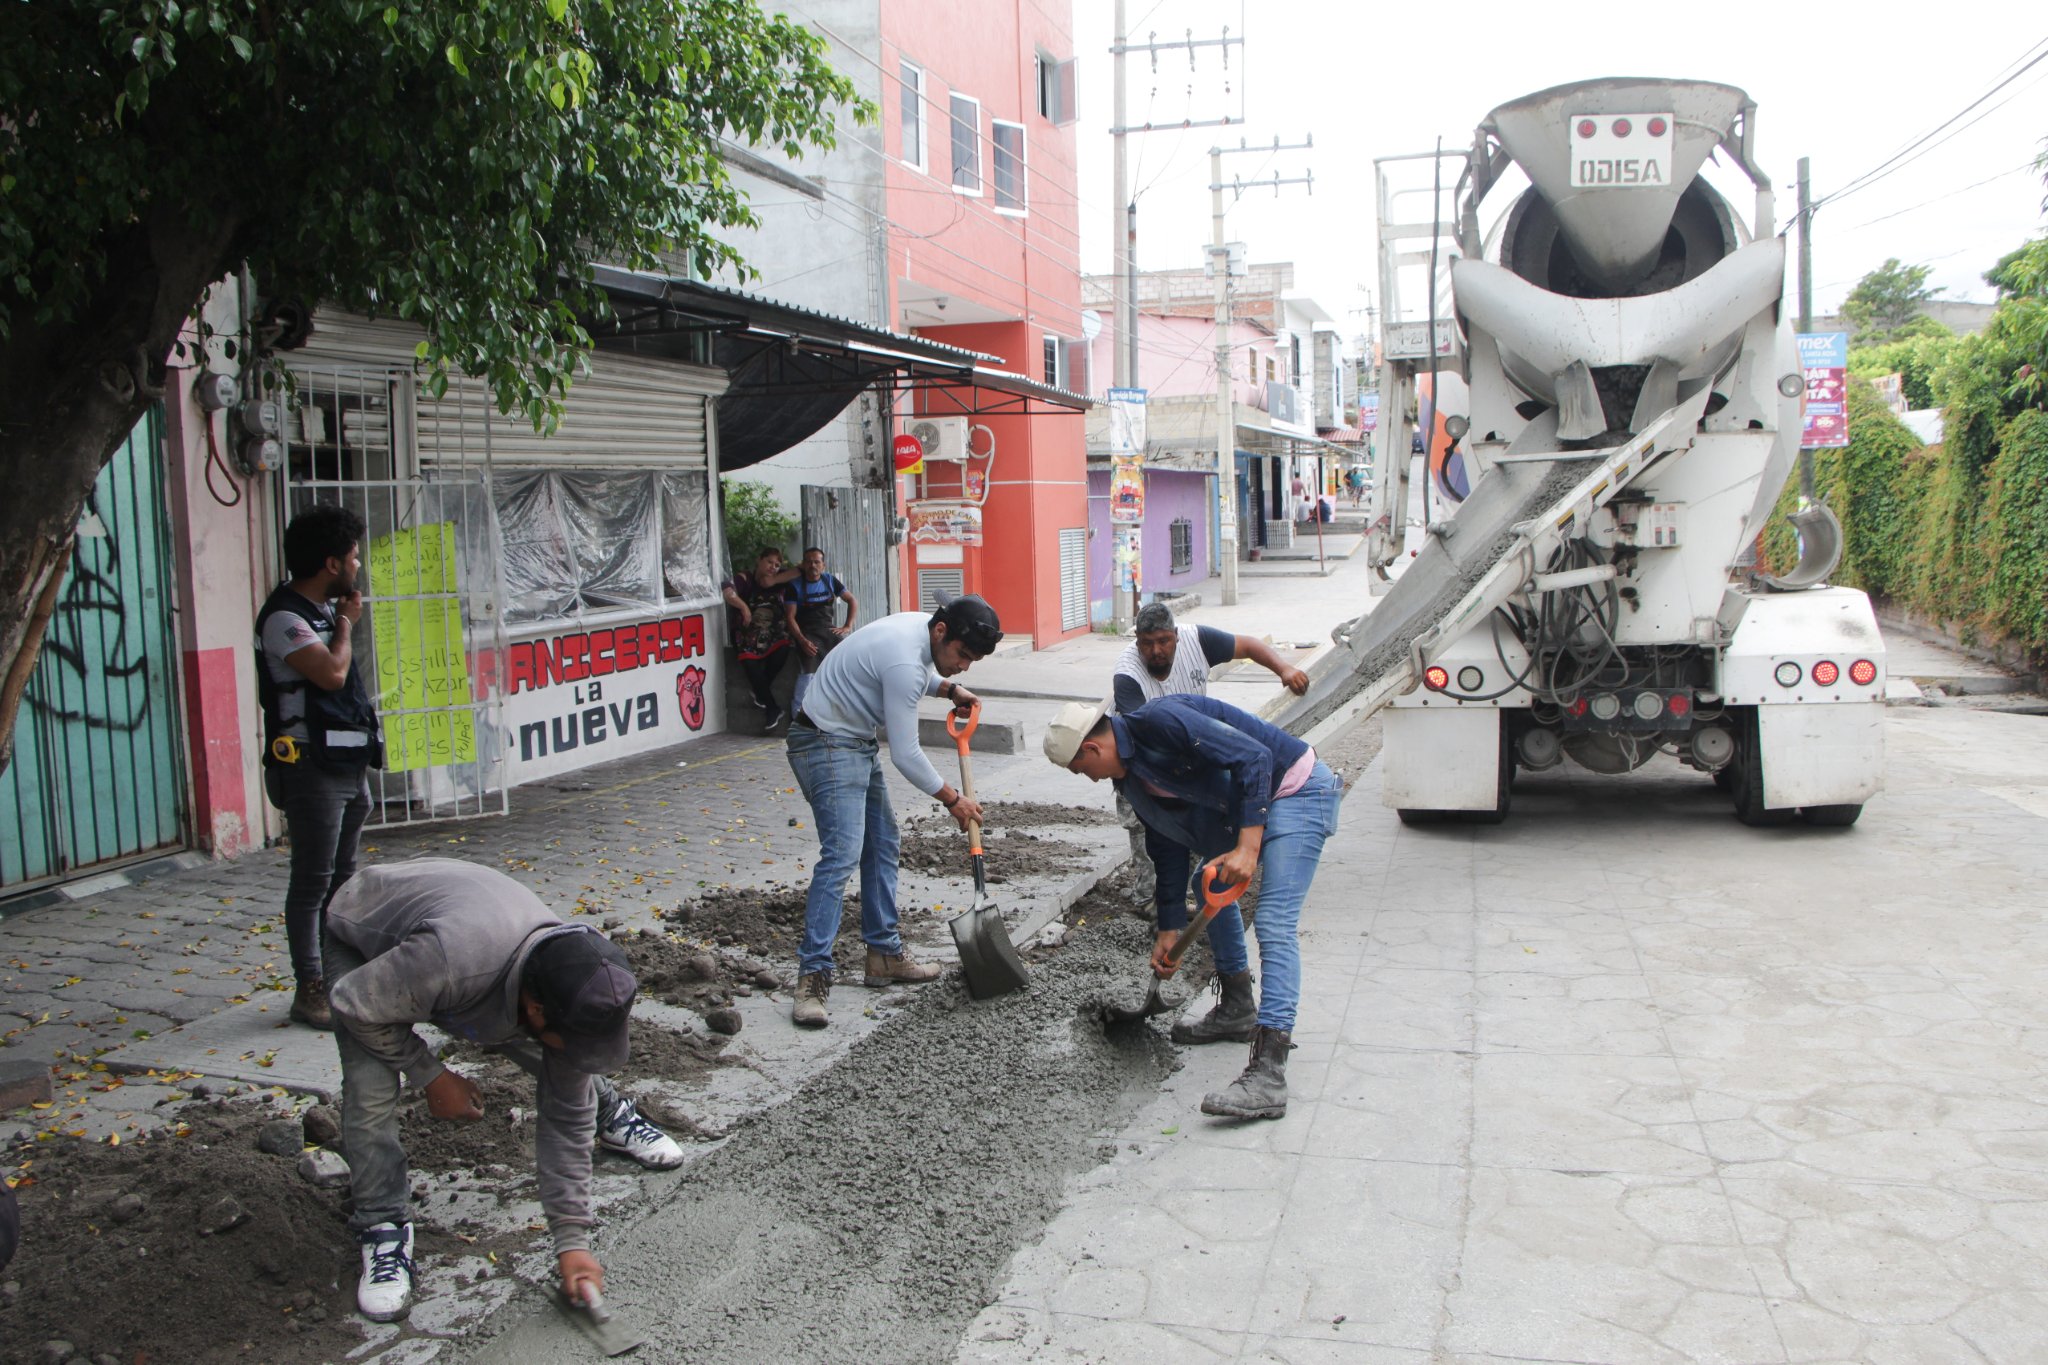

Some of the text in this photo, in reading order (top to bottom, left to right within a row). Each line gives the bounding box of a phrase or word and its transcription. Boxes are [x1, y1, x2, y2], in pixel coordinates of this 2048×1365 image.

[1580, 159, 1662, 184] ODISA
[896, 445, 916, 455] LALA
[381, 648, 461, 676] Costilla
